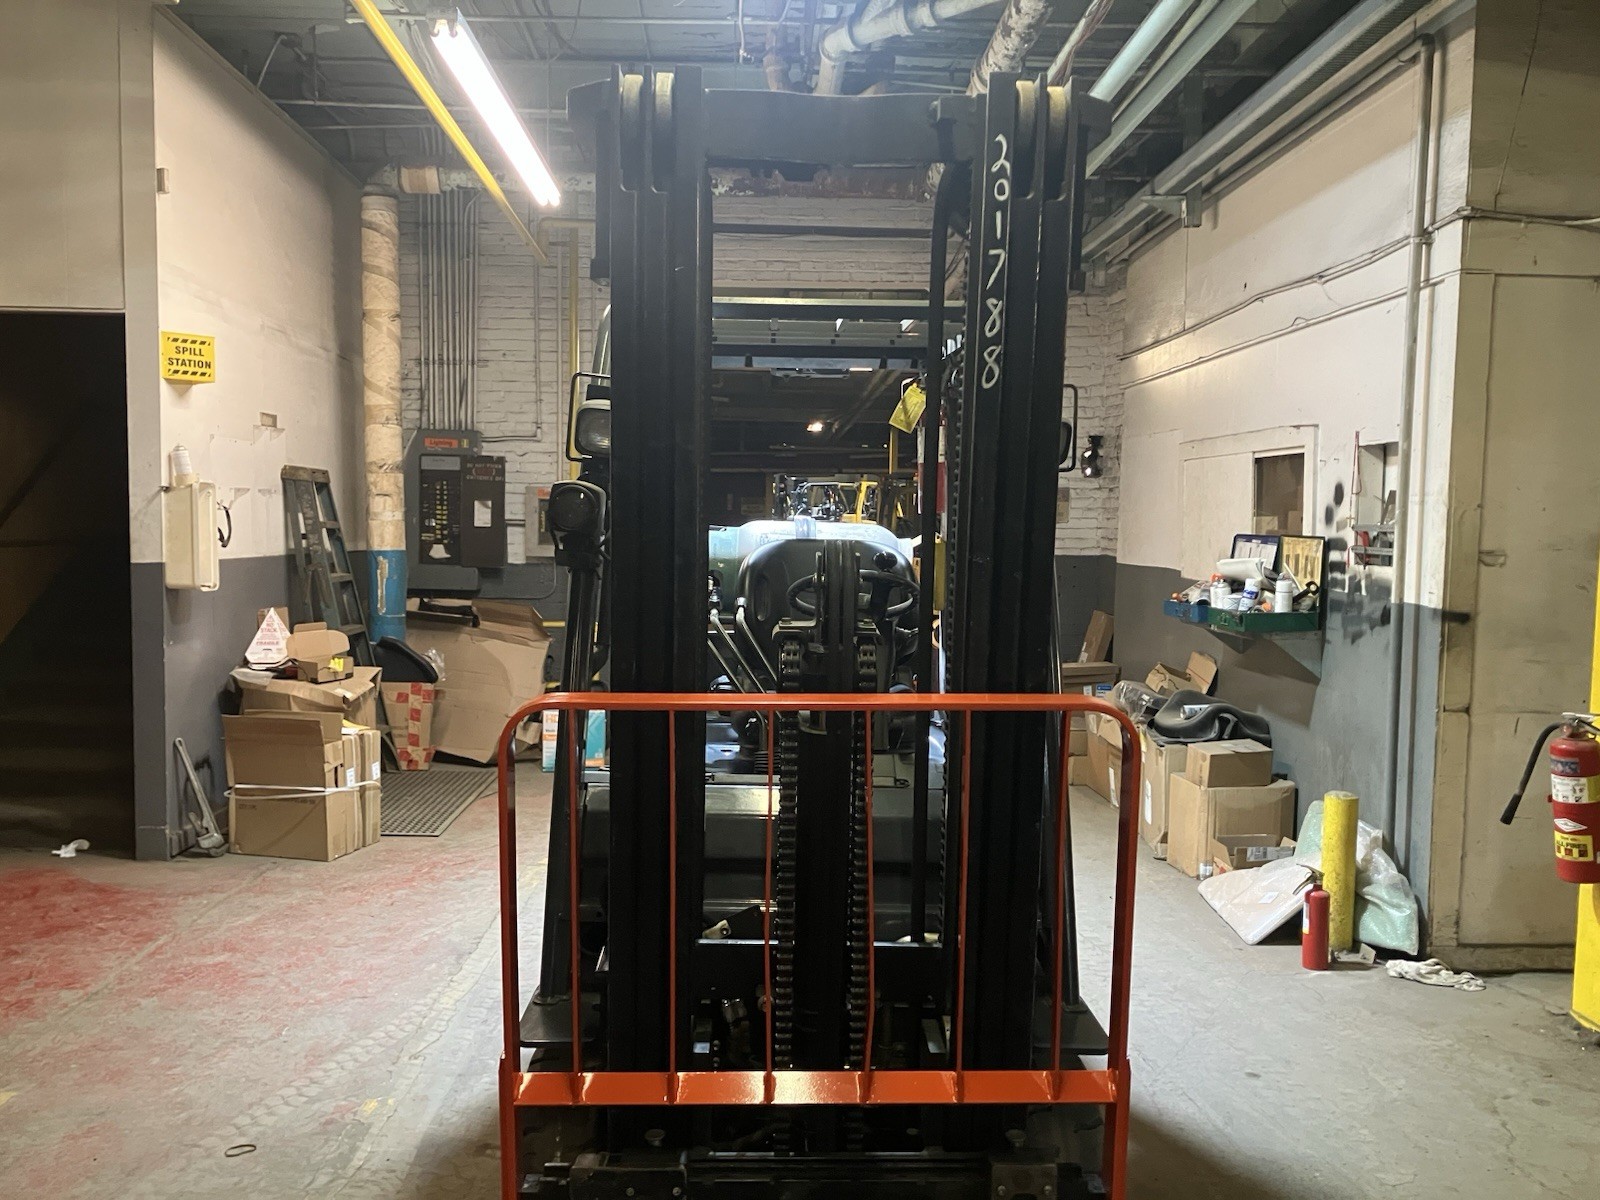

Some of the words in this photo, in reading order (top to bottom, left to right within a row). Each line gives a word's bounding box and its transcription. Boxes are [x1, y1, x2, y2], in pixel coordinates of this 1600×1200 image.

[982, 134, 1010, 389] 201788
[175, 346, 204, 357] SPILL
[168, 357, 211, 369] STATION
